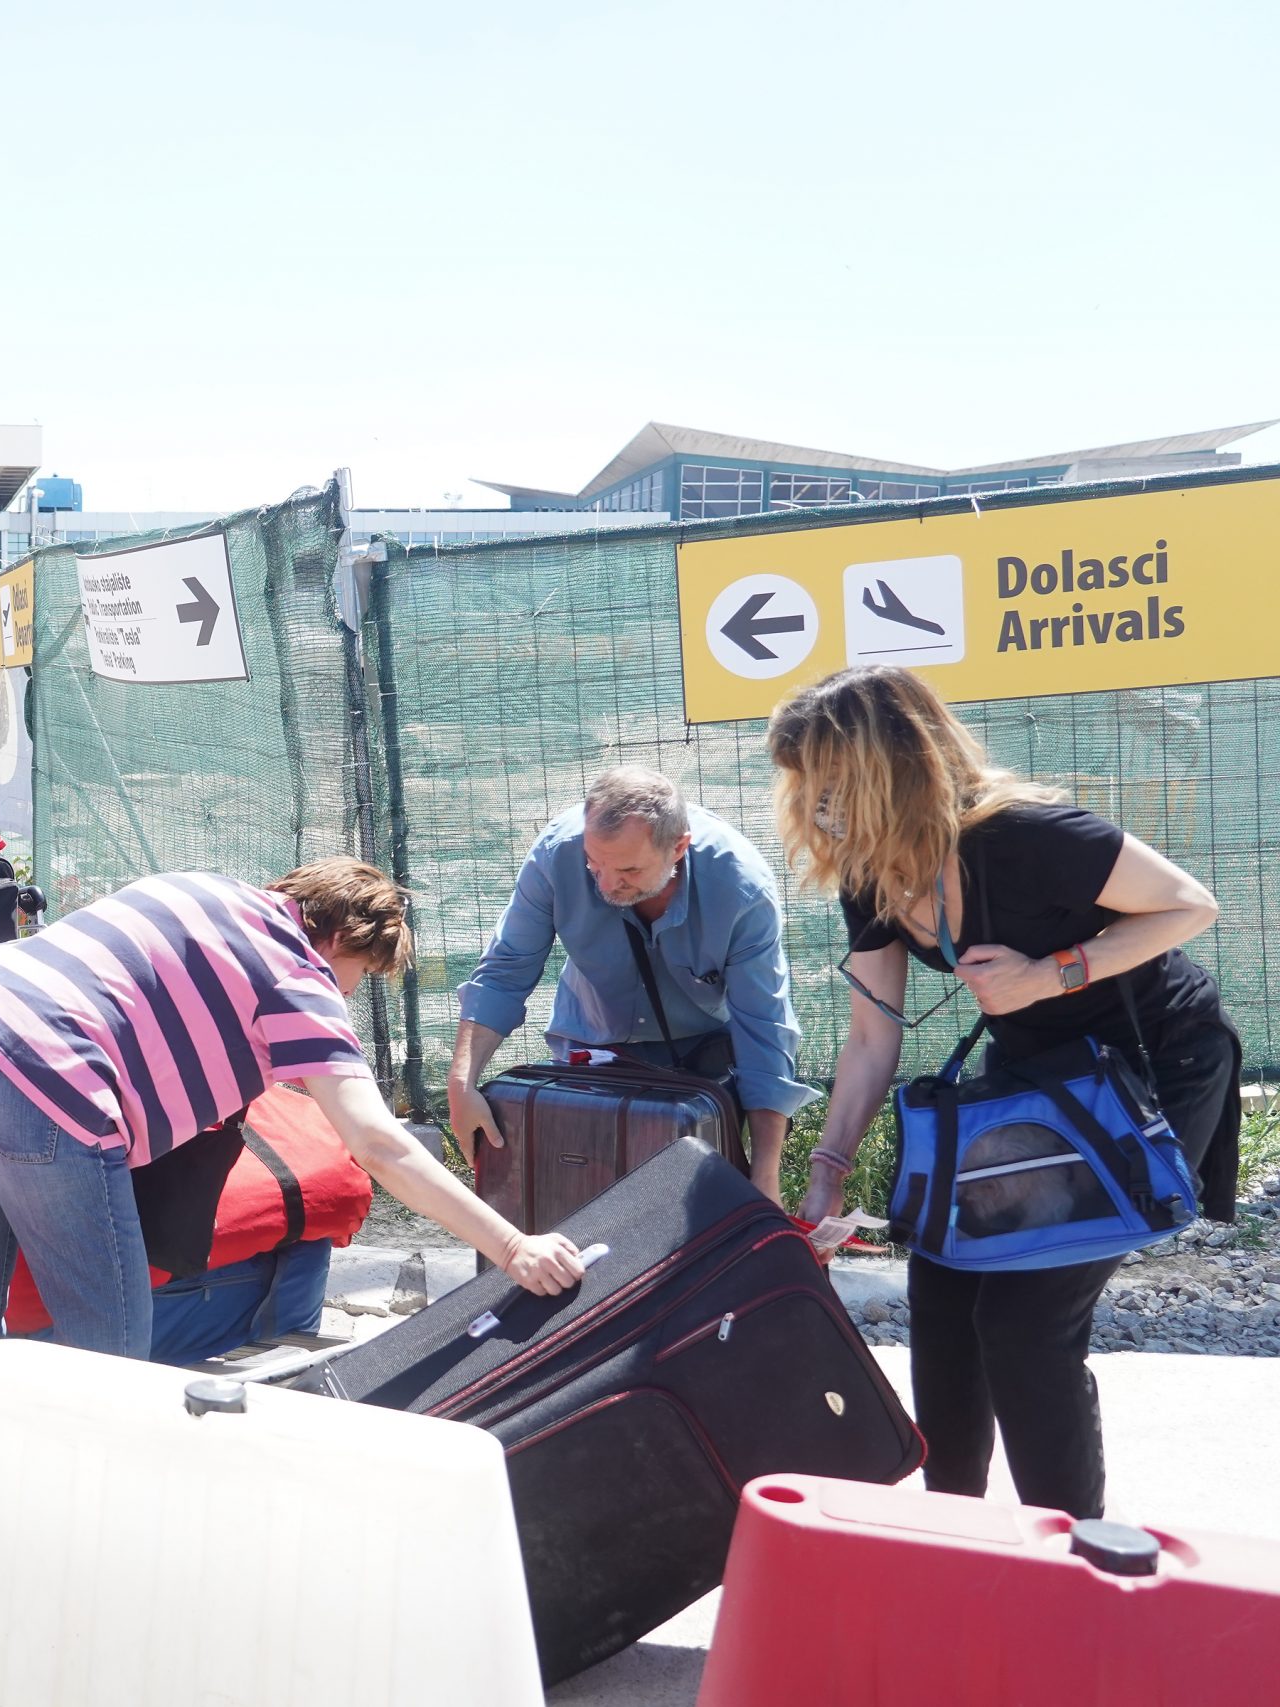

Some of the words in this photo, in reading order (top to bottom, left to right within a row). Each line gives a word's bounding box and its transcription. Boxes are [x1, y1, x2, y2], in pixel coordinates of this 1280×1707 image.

[996, 538, 1169, 599] Dolasci
[97, 596, 143, 621] Transportation
[996, 595, 1186, 653] Arrivals
